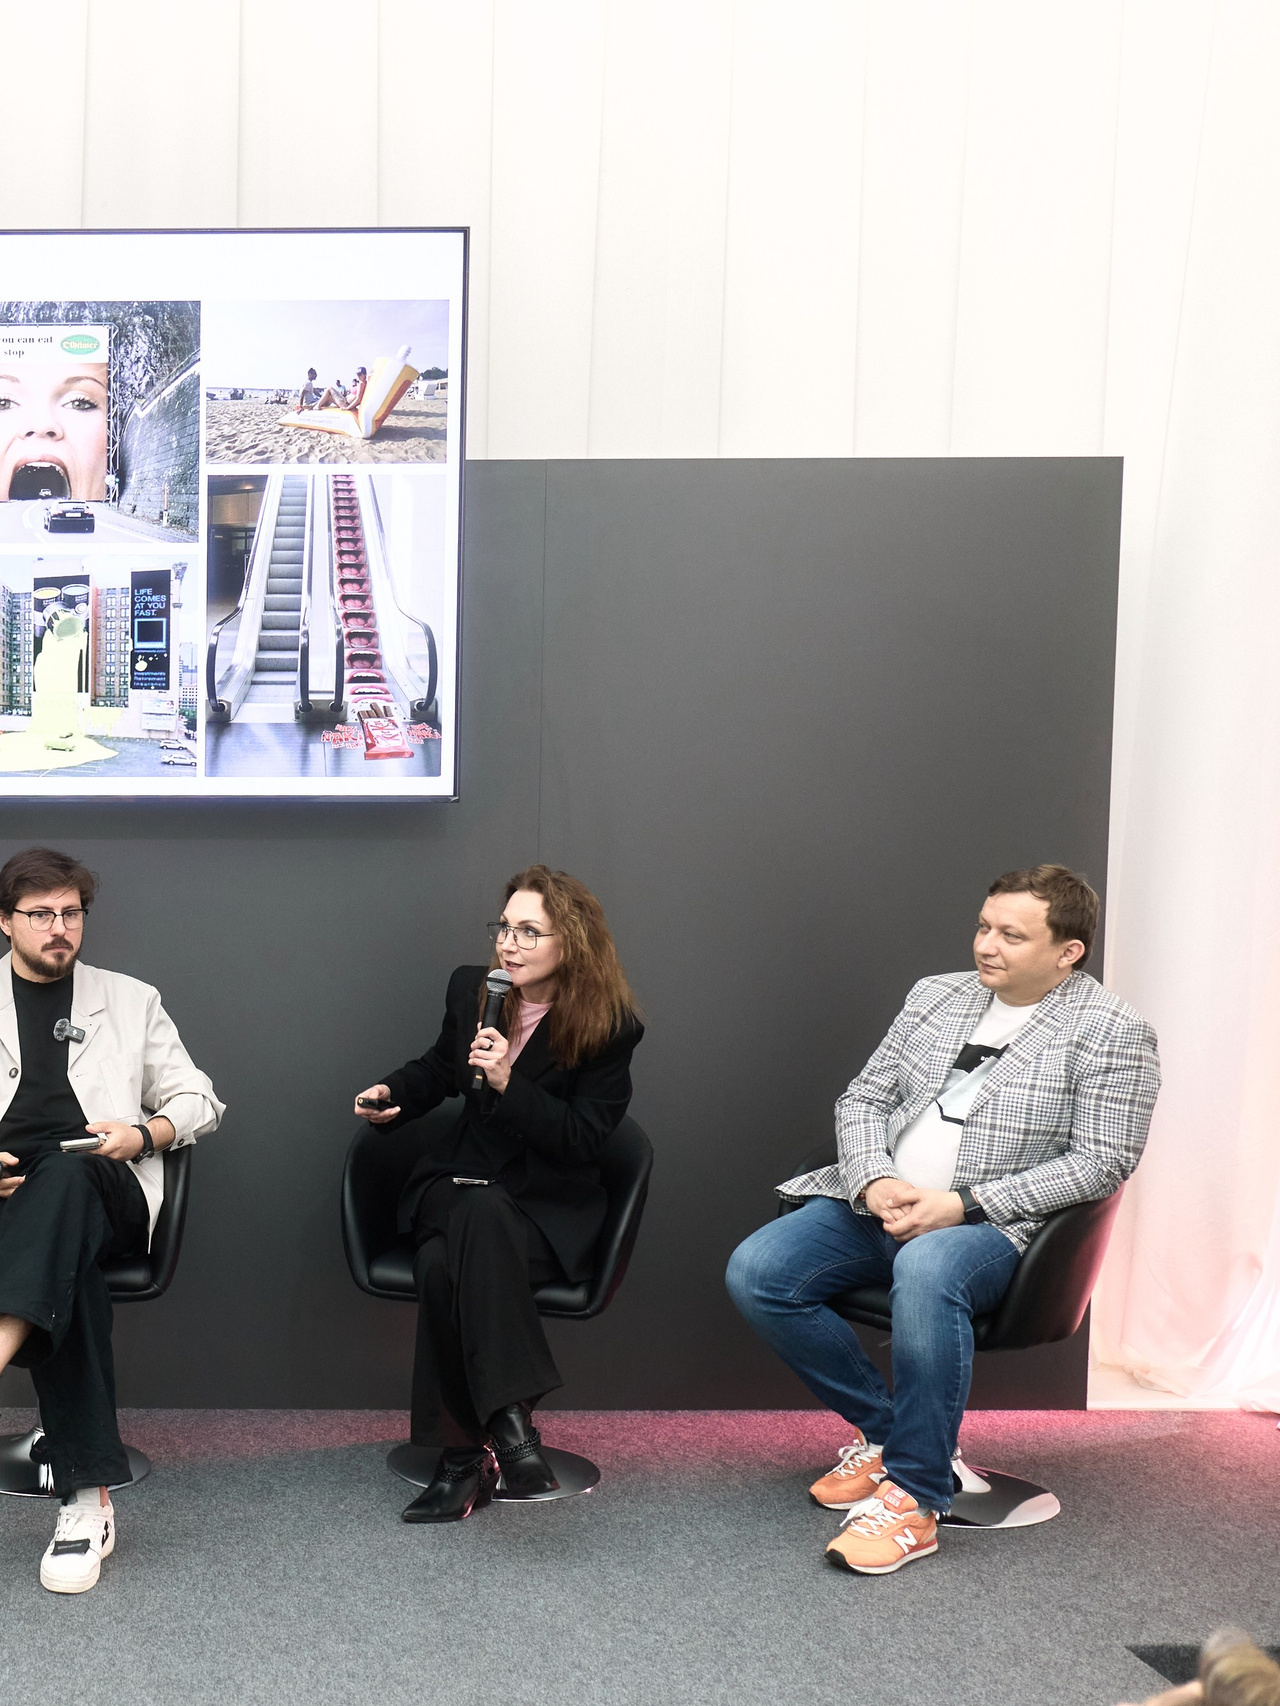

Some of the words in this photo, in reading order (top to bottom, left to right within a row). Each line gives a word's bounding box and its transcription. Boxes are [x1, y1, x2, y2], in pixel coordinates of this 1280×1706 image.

[3, 347, 25, 358] stop
[134, 588, 153, 596] LIFE
[893, 1527, 918, 1554] N
